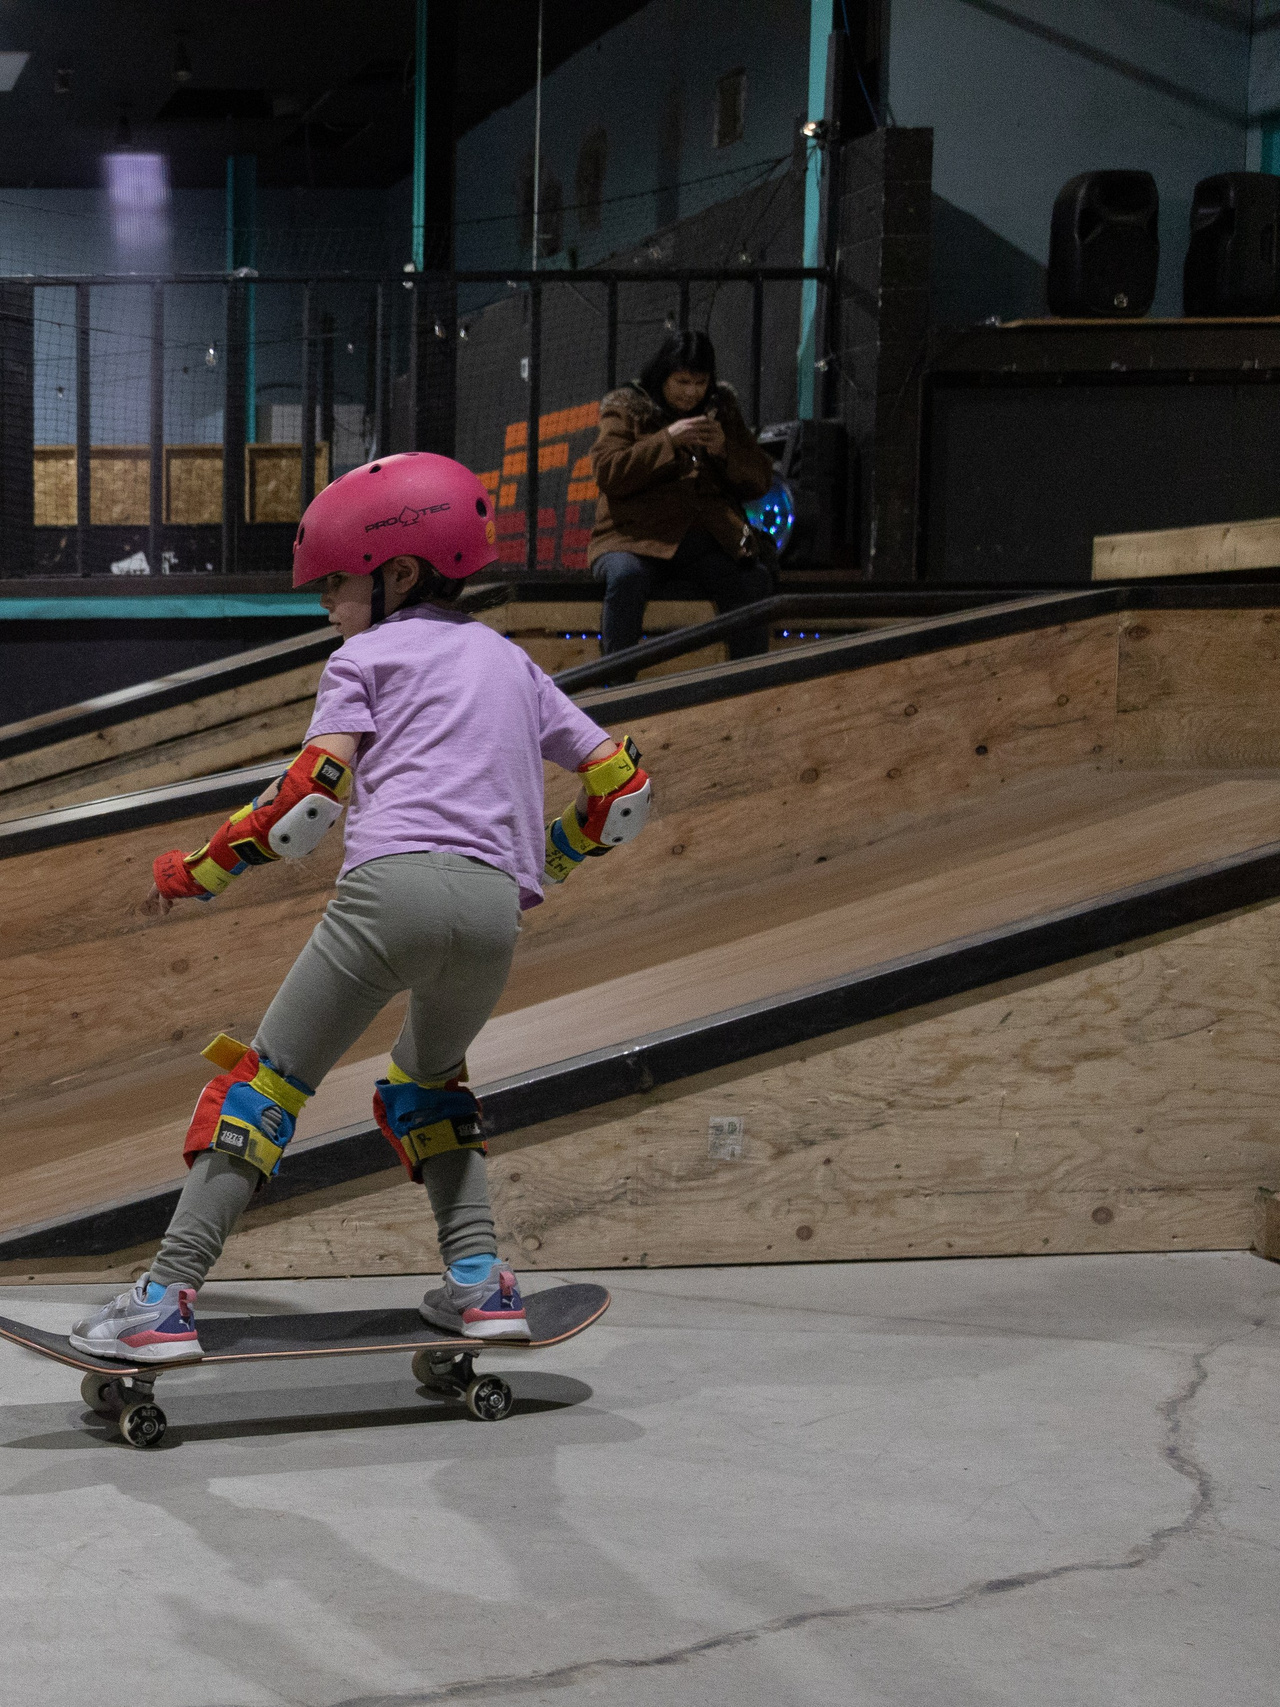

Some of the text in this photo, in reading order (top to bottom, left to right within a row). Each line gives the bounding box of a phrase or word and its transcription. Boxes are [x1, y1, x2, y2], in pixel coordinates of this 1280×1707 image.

[365, 503, 451, 533] PRO TEC
[222, 1130, 244, 1143] 1973
[416, 1132, 431, 1147] R
